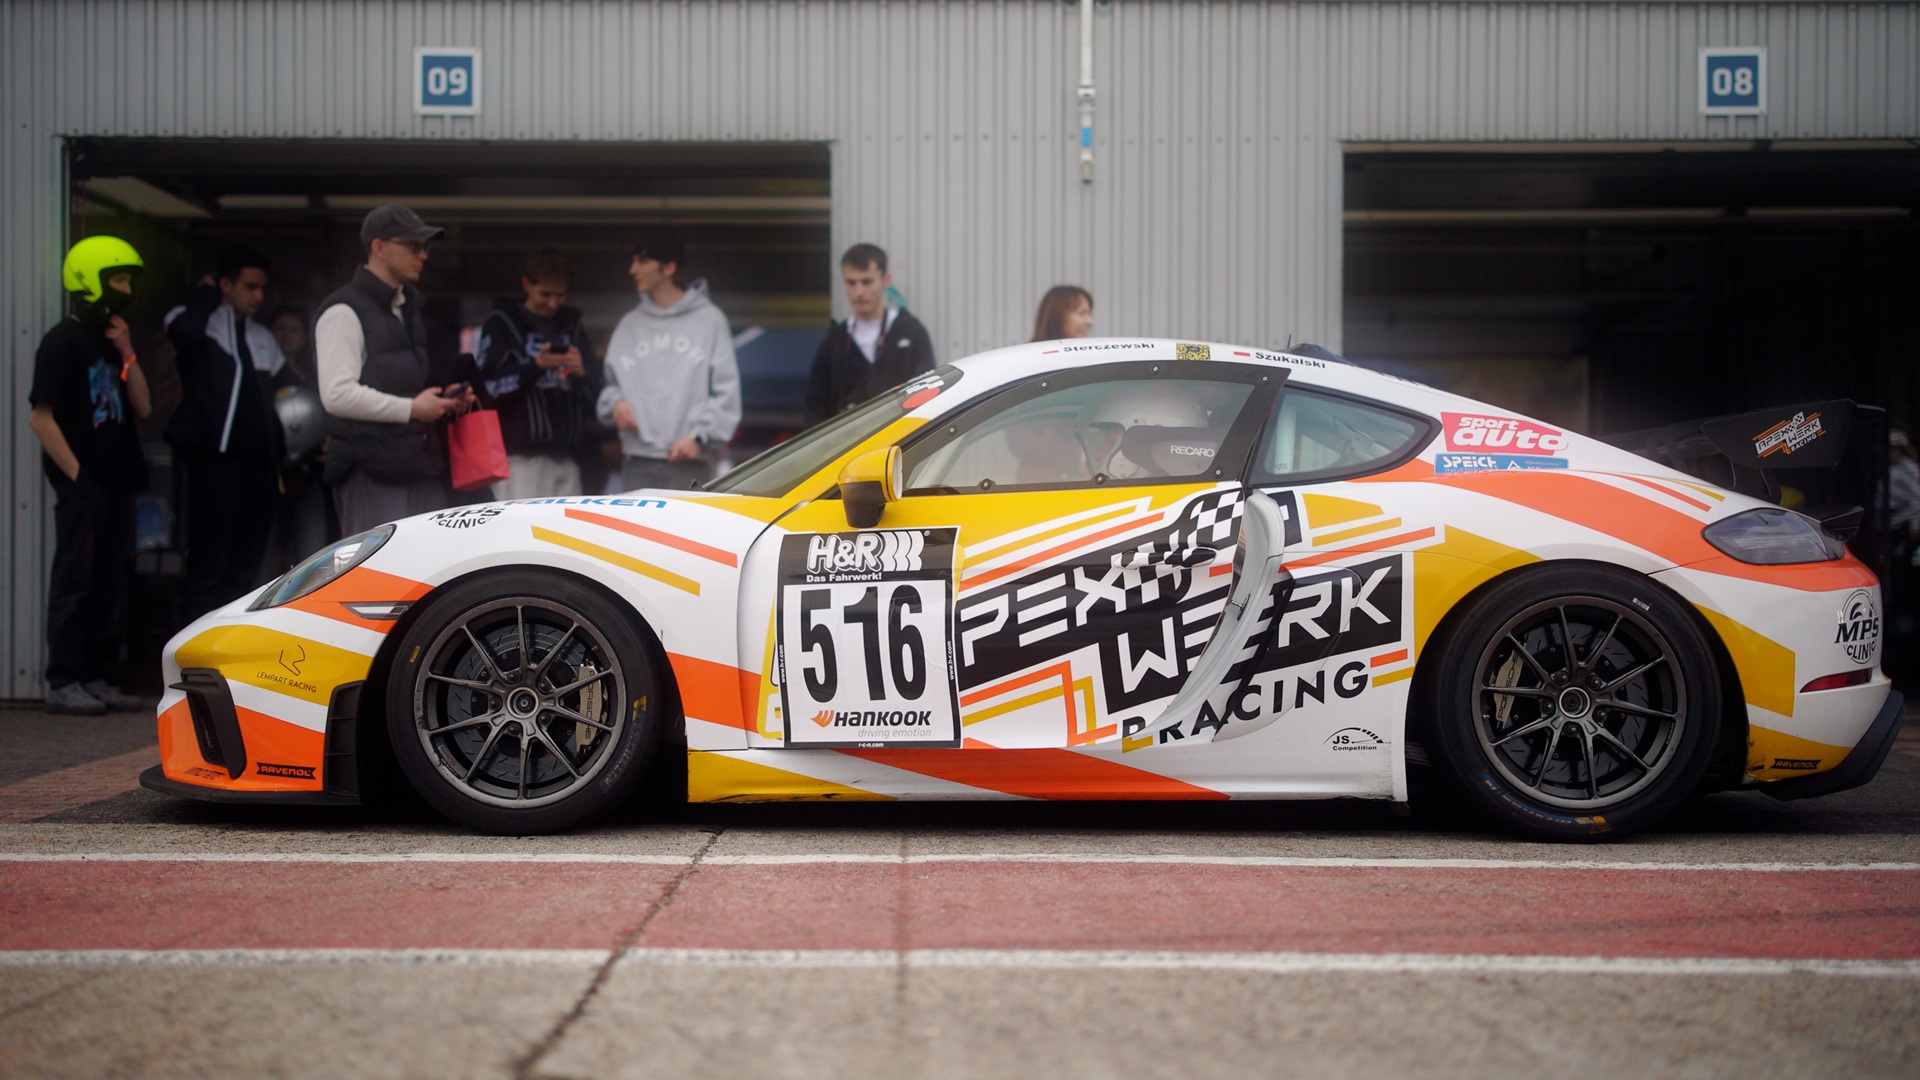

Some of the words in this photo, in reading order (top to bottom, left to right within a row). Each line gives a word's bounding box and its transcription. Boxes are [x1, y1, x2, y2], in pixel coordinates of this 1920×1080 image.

[428, 67, 468, 96] 09
[1712, 67, 1753, 96] 08
[1255, 351, 1325, 369] Szukalski
[1458, 416, 1519, 432] sport
[1787, 420, 1819, 444] WERK
[1453, 426, 1569, 451] auto
[1791, 434, 1818, 452] RACING
[1170, 445, 1215, 458] RECARO
[429, 507, 504, 521] MPS
[438, 517, 487, 529] CLINIC
[807, 533, 884, 574] H&R
[806, 574, 826, 582] Das
[829, 572, 882, 582] Fahrwerk!
[1834, 616, 1880, 644] MPS
[800, 584, 927, 703] 516
[1846, 640, 1876, 661] CLINIC
[257, 670, 289, 686] LEMPART
[288, 679, 317, 693] RACING
[857, 728, 890, 739] driving
[892, 727, 932, 738] emotion
[1332, 735, 1350, 745] JS
[261, 765, 313, 777] RAVENOL
[1776, 760, 1817, 769] RAVENOL
